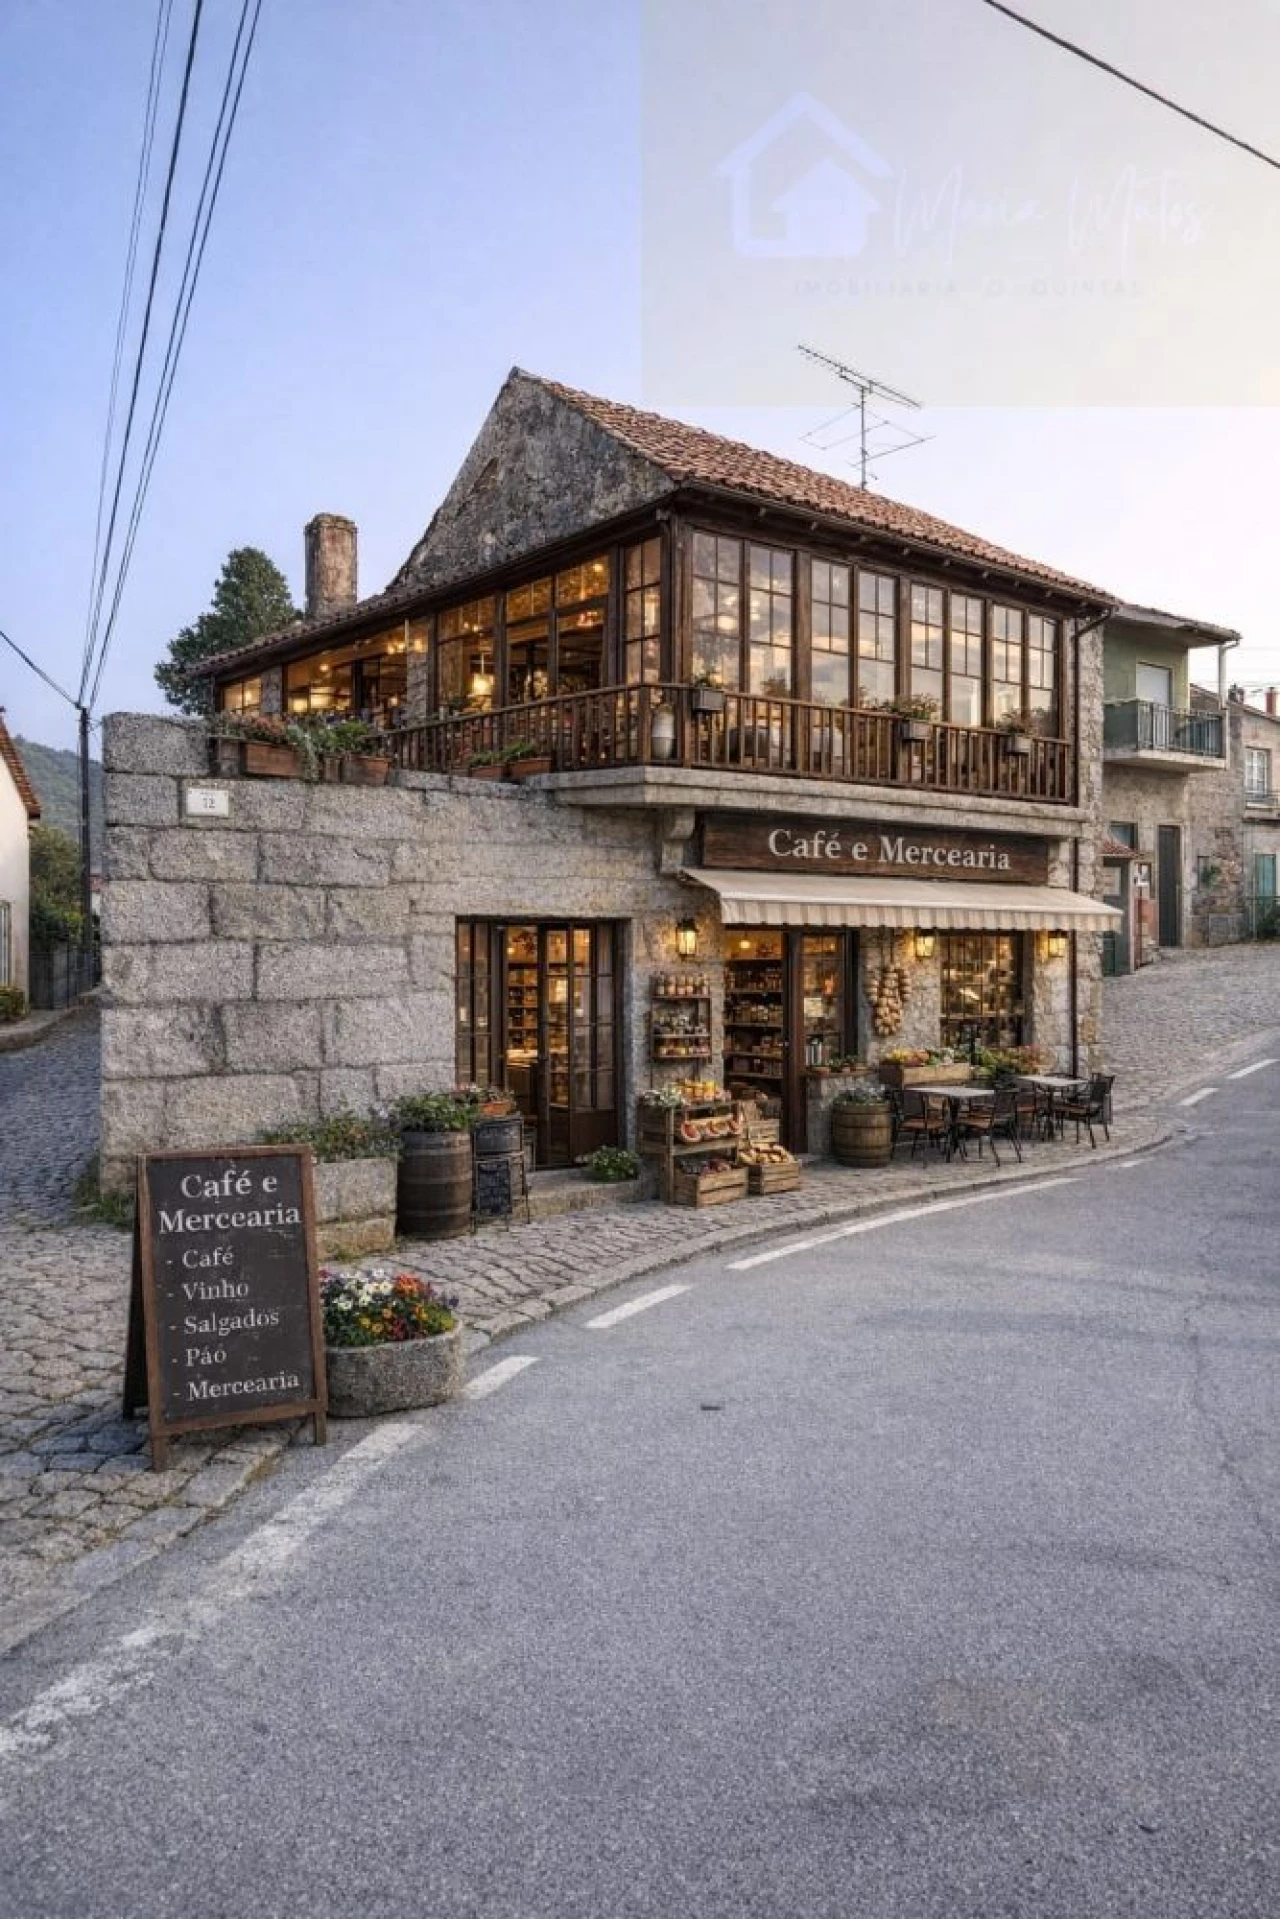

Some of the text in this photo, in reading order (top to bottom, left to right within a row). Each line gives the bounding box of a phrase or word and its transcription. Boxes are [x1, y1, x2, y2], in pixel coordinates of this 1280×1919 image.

[768, 829, 1012, 870] Café e Mercearia
[181, 1170, 278, 1198] Café e
[158, 1202, 302, 1235] Mercearia
[182, 1245, 234, 1269] Café
[182, 1279, 249, 1300] Vinho
[184, 1308, 280, 1336] Salgados
[186, 1371, 300, 1401] Mercearia
